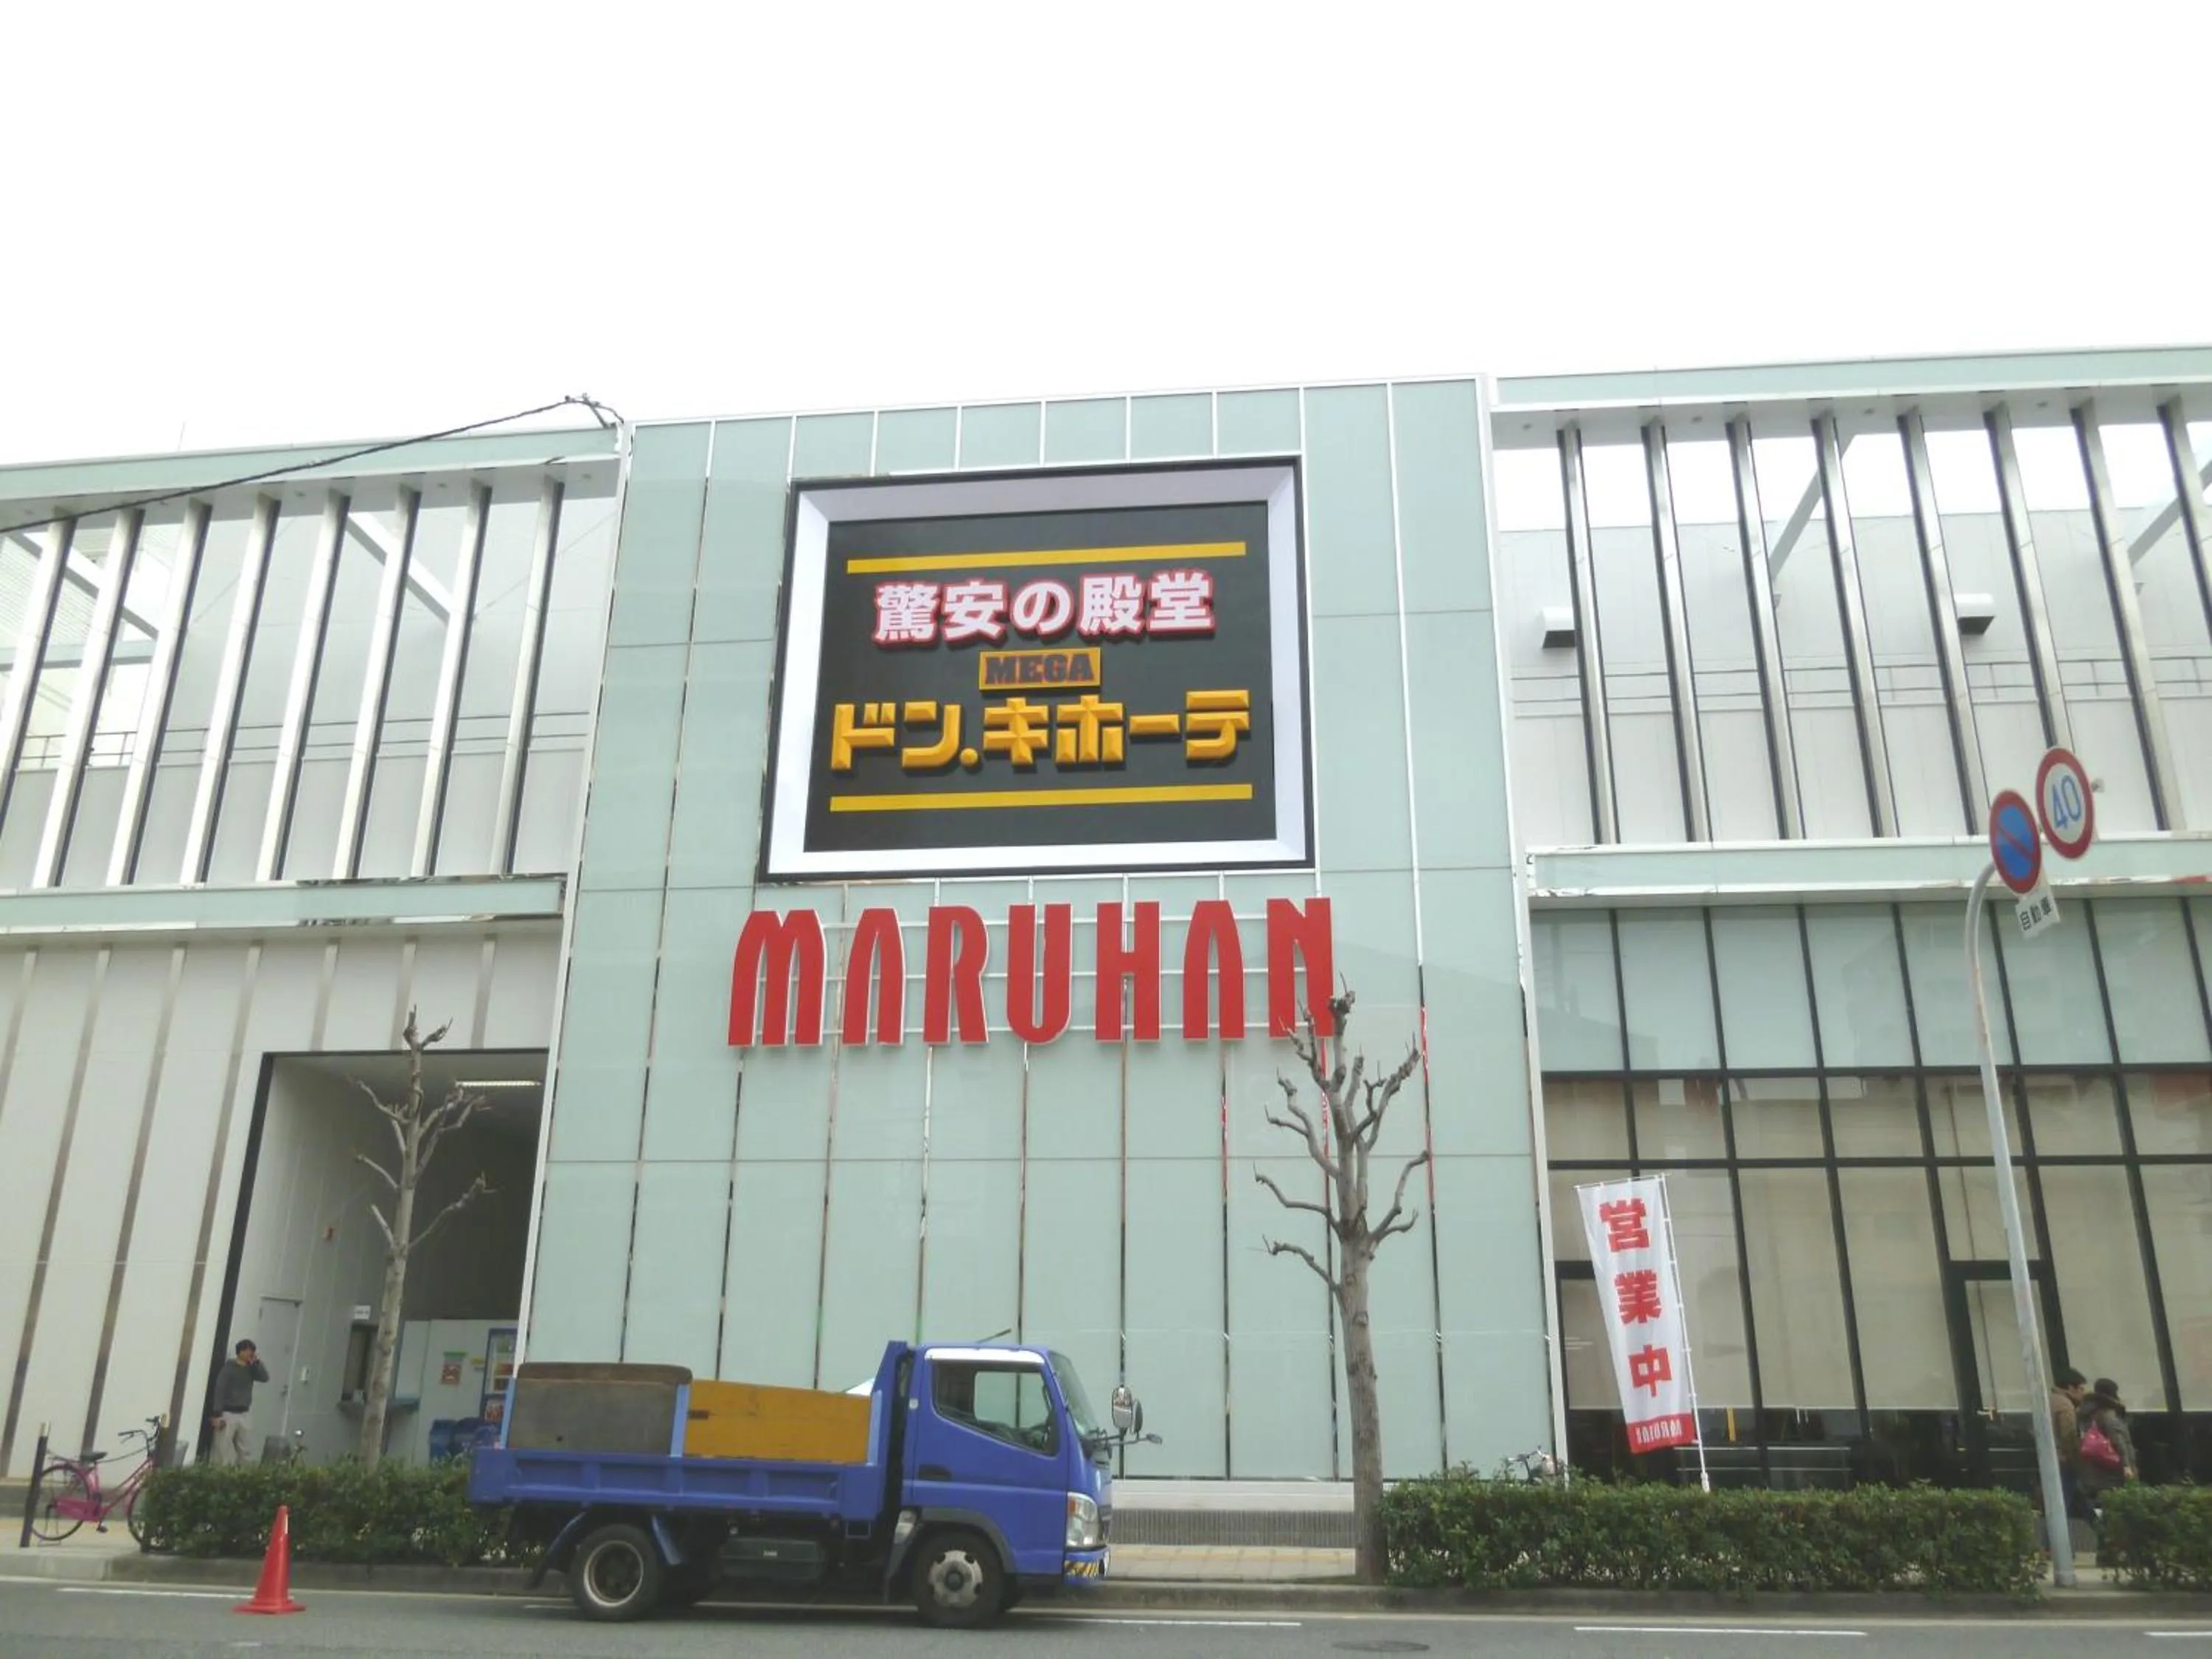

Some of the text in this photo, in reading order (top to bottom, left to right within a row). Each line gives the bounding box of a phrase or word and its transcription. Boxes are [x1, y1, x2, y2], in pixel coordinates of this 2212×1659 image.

[872, 568, 1215, 644] 驚安の殿堂
[985, 653, 1094, 686] MEGA
[2051, 775, 2081, 830] 40
[728, 897, 1333, 1047] MARUHAN
